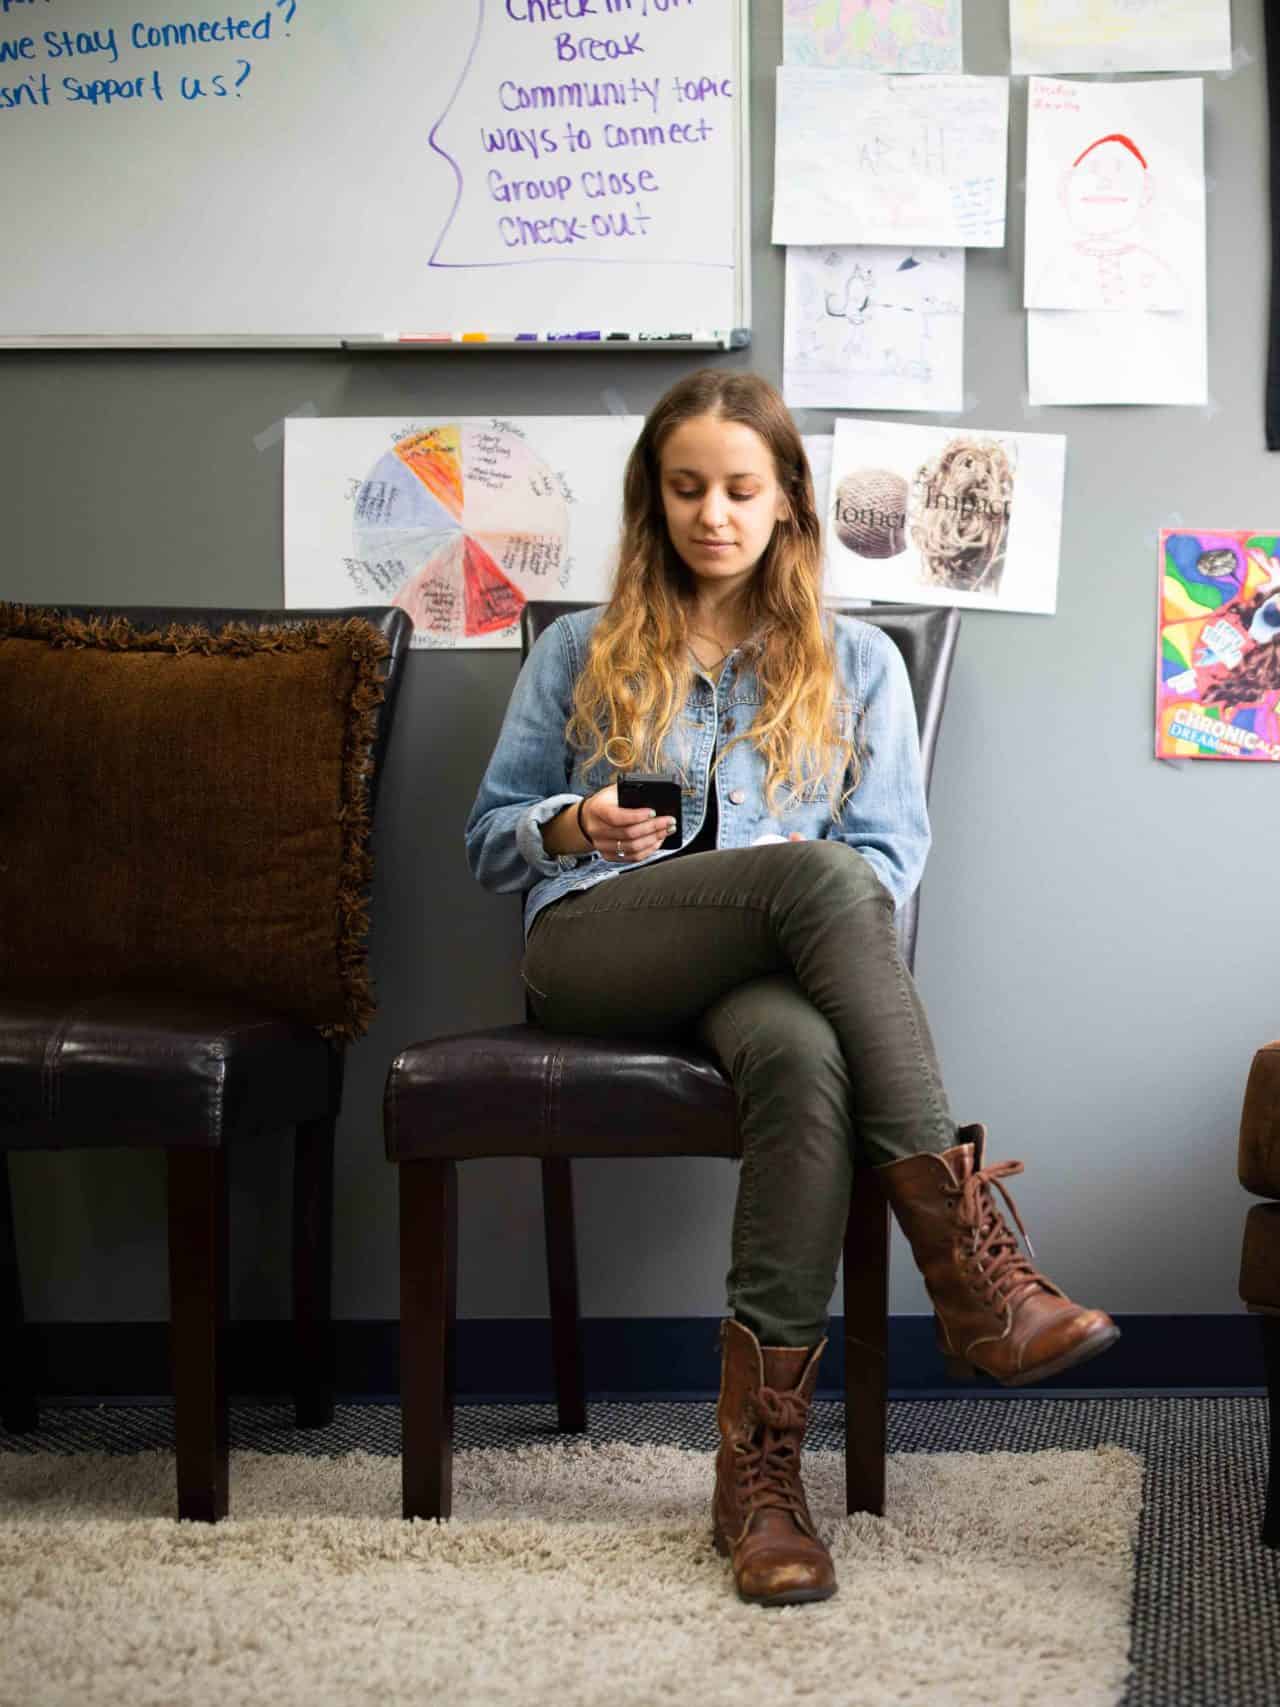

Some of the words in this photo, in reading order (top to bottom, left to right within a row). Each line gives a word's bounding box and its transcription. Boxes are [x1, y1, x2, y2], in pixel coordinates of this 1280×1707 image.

[555, 32, 645, 62] Break
[0, 73, 51, 108] sn't
[499, 77, 660, 113] Community
[672, 77, 733, 104] topic
[563, 122, 591, 153] to
[487, 169, 572, 202] Group
